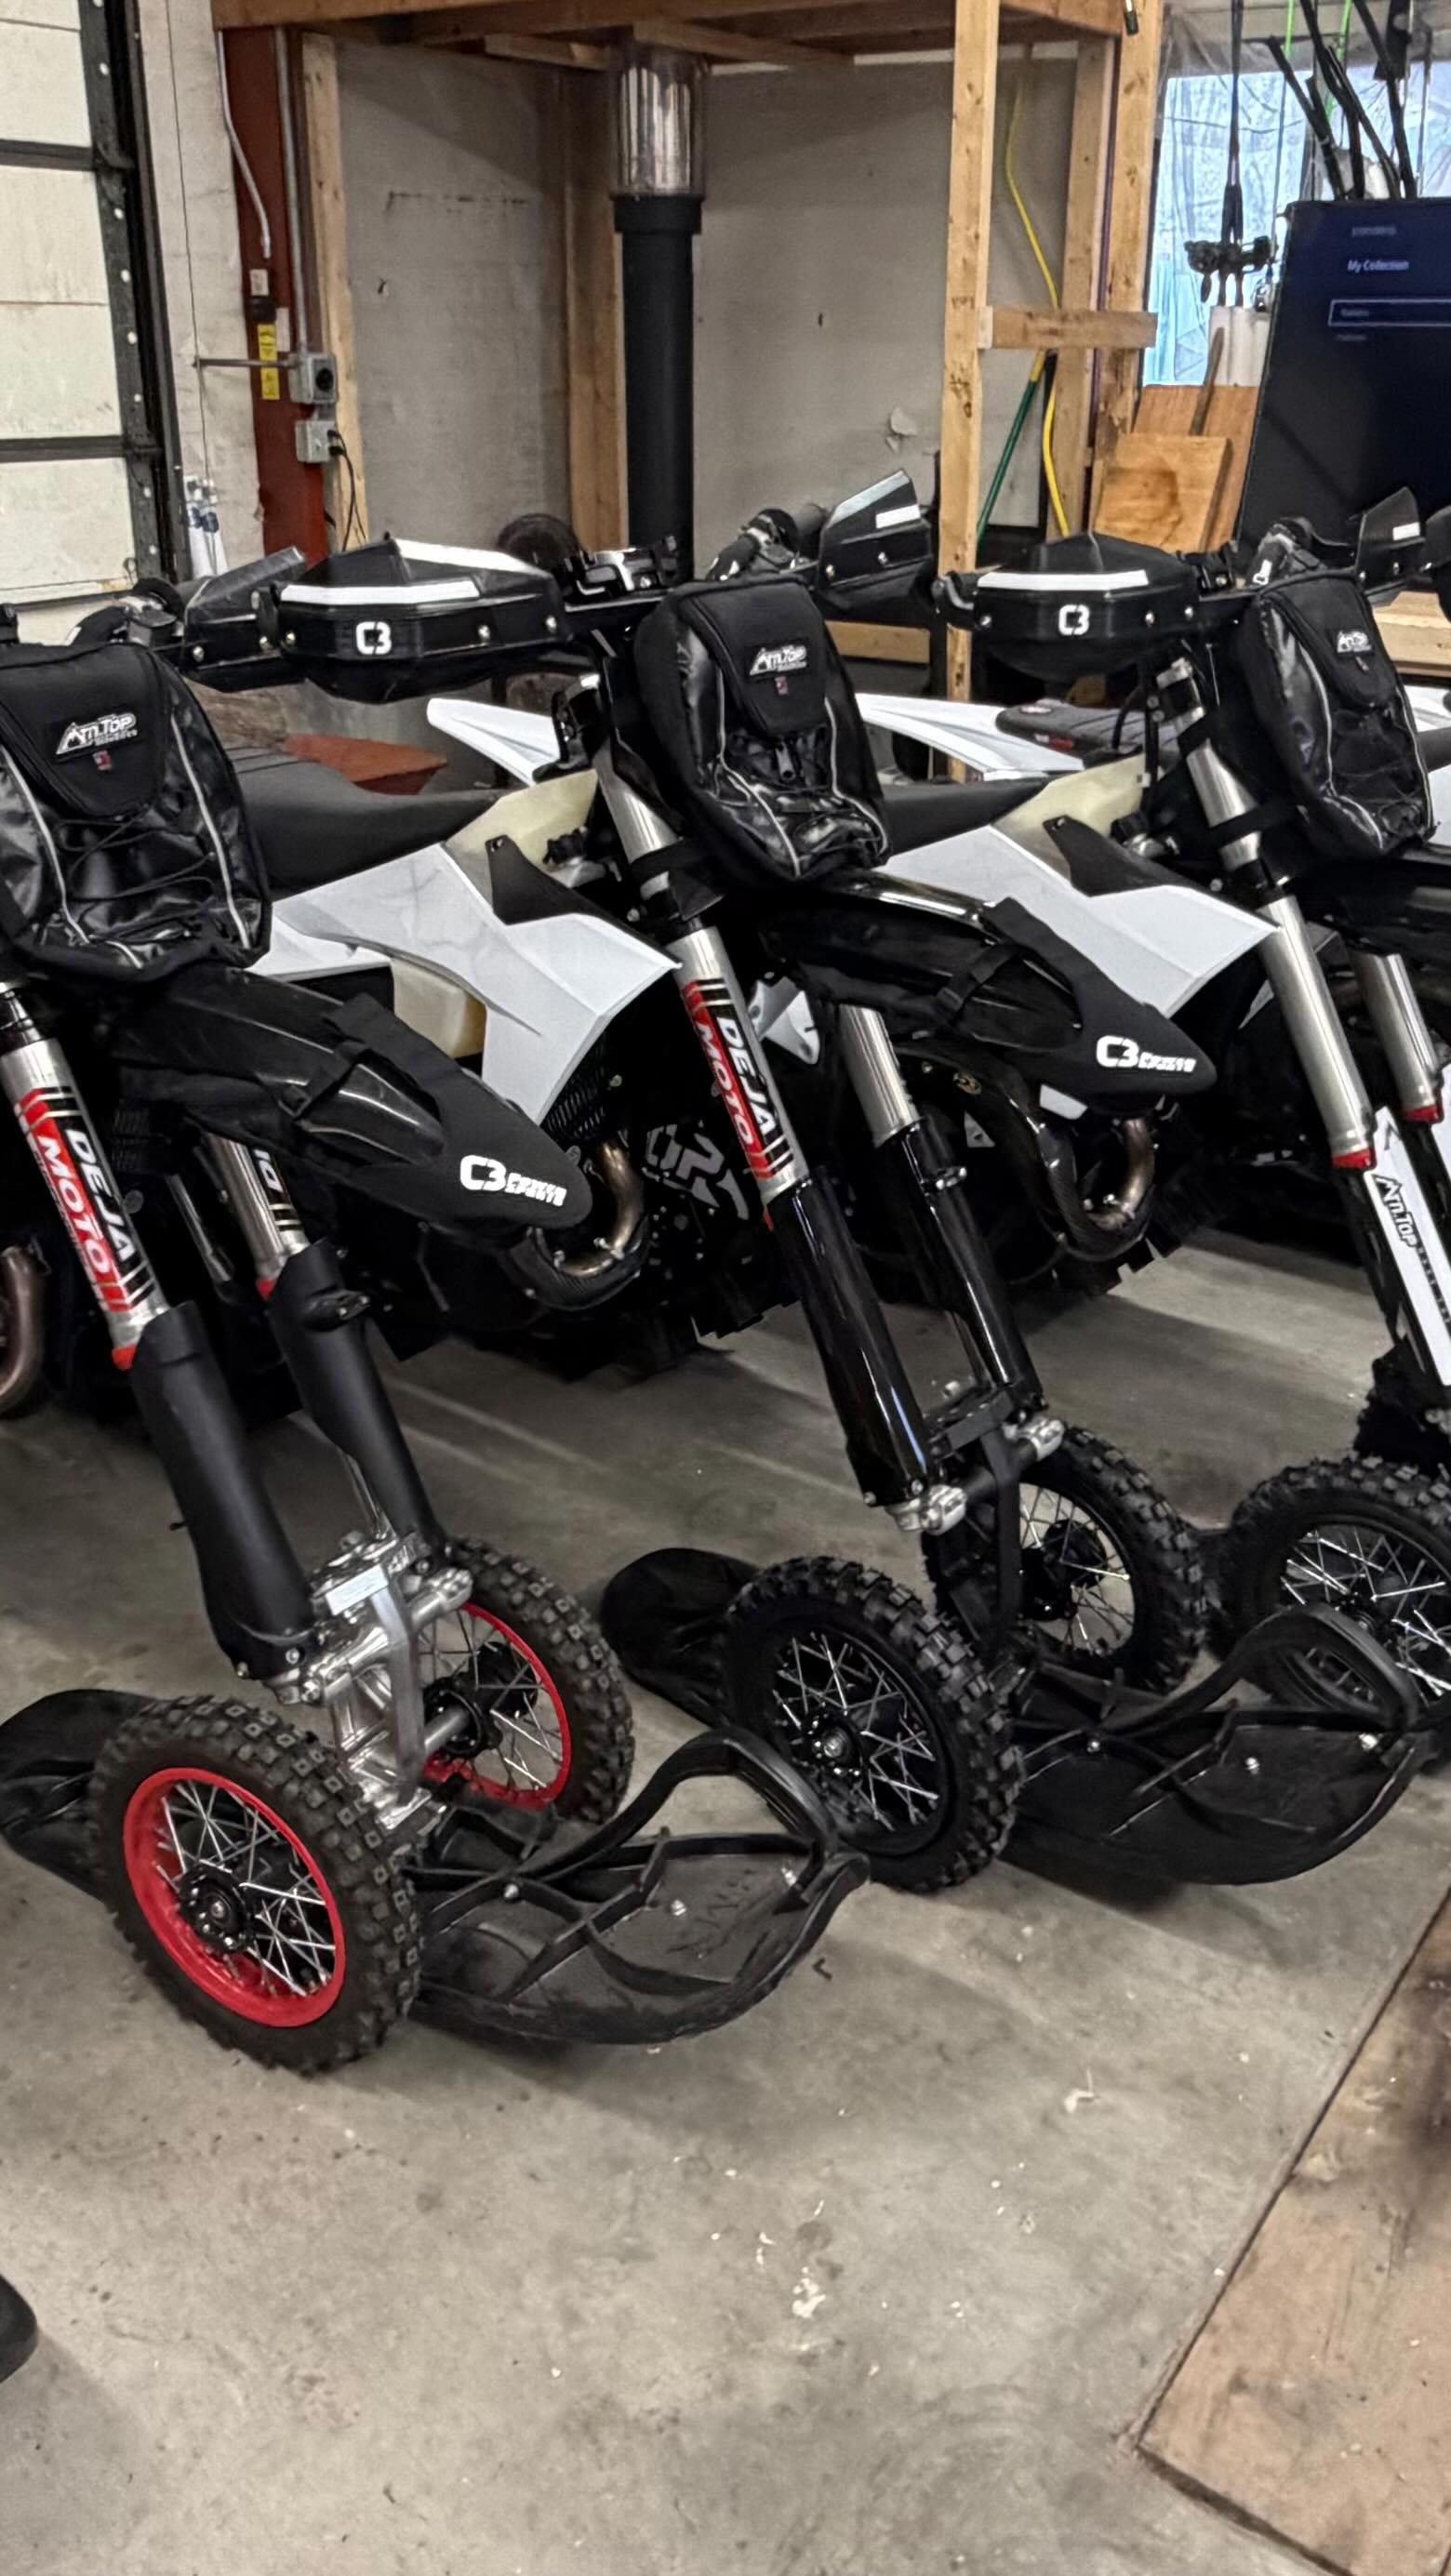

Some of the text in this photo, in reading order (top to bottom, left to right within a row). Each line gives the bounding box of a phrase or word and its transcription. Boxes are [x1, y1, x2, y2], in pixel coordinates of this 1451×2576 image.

[1347, 259, 1409, 272] My Collection
[355, 621, 392, 655] C3
[1058, 604, 1089, 635] C3
[697, 1023, 754, 1146] MOTO
[716, 1016, 777, 1135] DEJA
[38, 1135, 111, 1275] MOTO
[64, 1128, 137, 1262] DEJA
